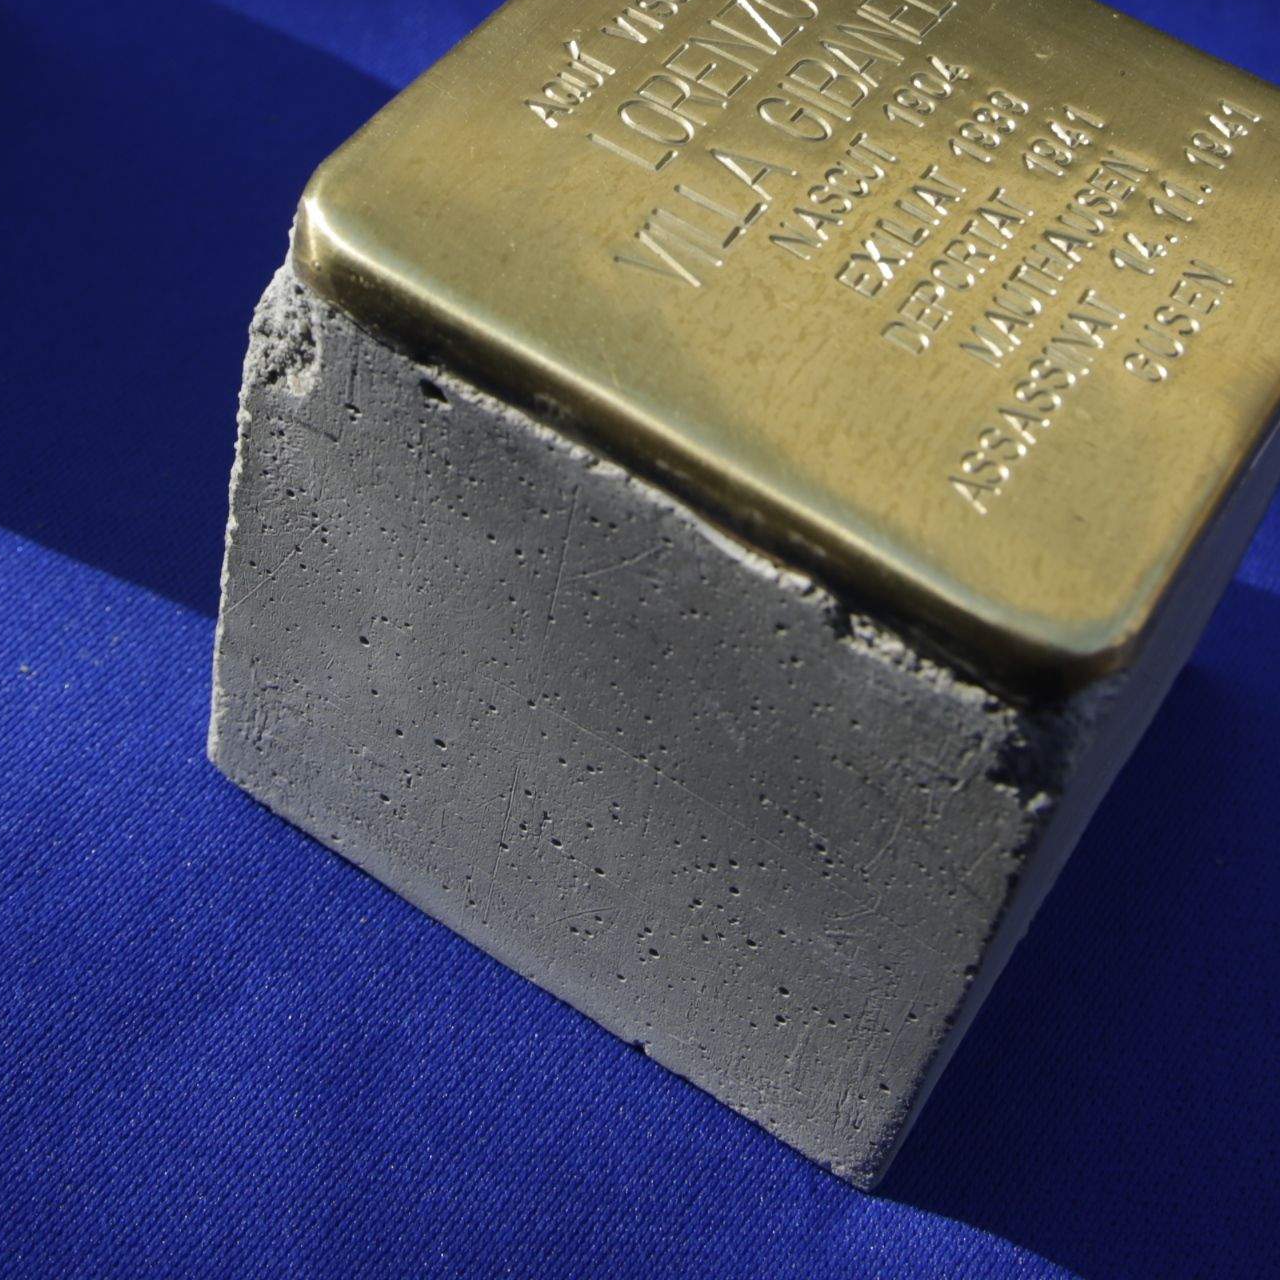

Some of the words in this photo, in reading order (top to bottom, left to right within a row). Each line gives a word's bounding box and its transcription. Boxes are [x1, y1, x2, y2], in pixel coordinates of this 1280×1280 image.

[613, 144, 800, 288] VILLA
[768, 131, 897, 261] NASCUT
[883, 54, 971, 129] 1904
[835, 163, 968, 300] EXILIAT
[948, 89, 1032, 166] 1939
[882, 186, 1034, 357] DEPORTAT
[1021, 103, 1107, 179] 1941
[960, 148, 1151, 369] MAUTHAUSEN
[947, 288, 1125, 515] ASSASSINAT
[1122, 257, 1235, 384] GUSEN
